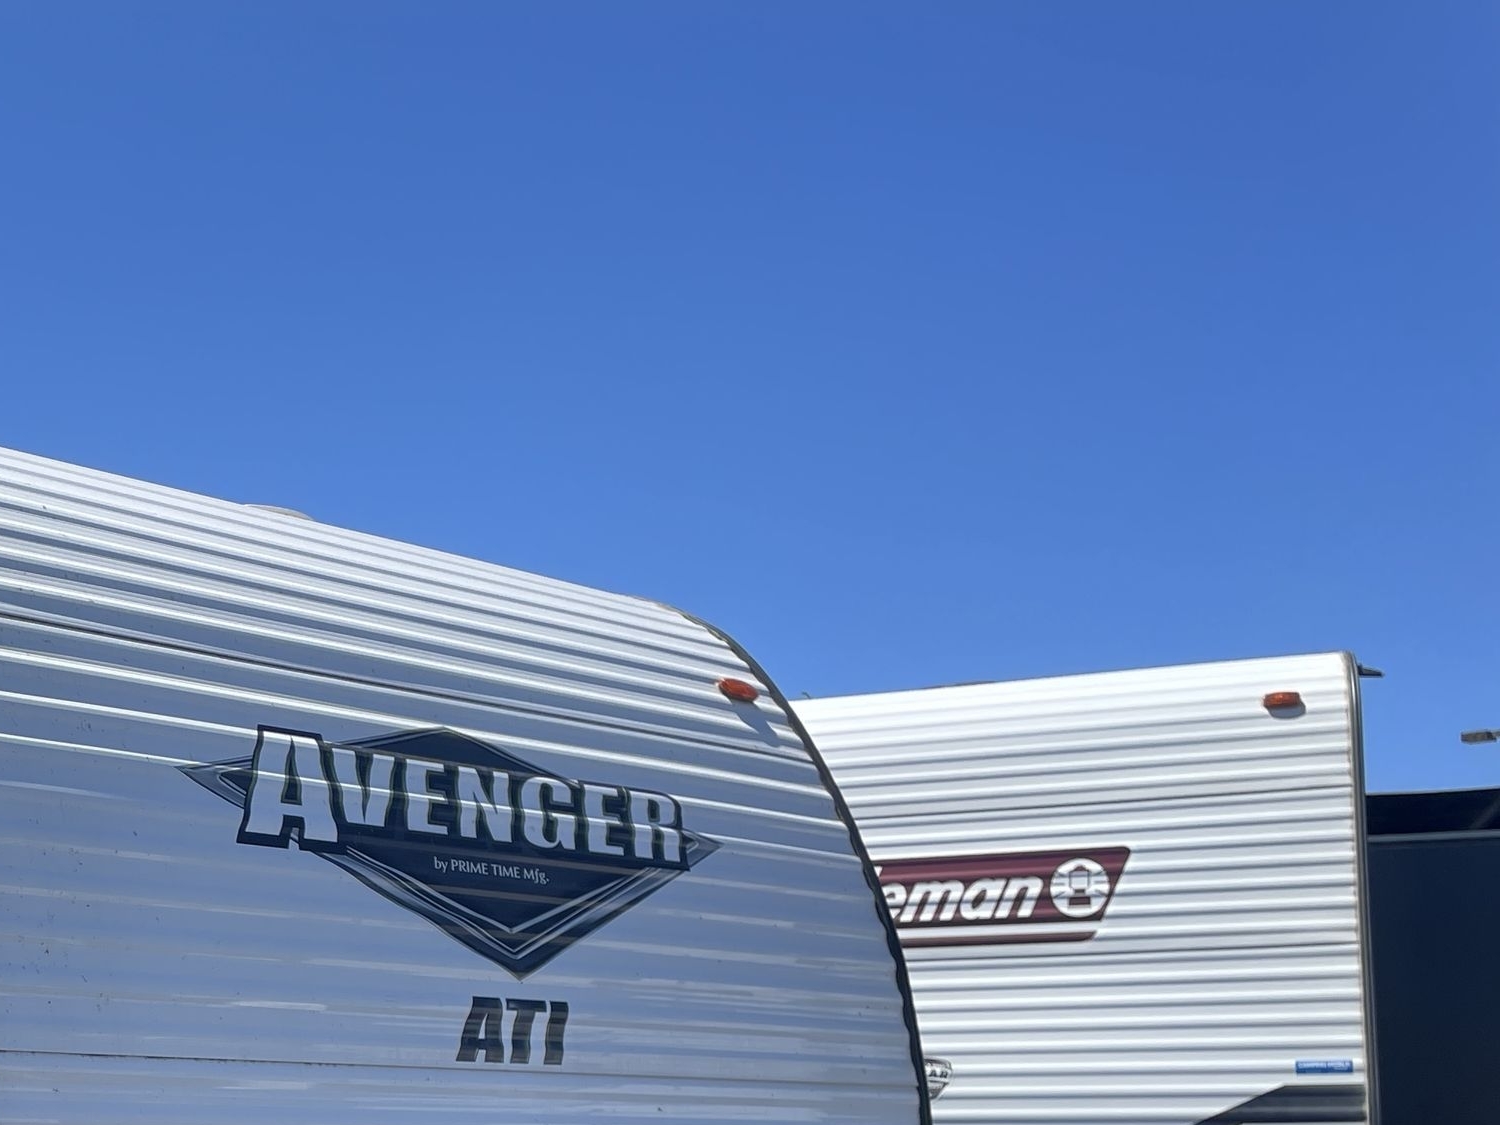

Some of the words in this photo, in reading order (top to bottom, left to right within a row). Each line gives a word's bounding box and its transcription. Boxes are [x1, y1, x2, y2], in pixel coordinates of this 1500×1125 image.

[238, 725, 689, 871] AVENGER
[433, 856, 448, 873] by
[451, 859, 489, 875] PRIME
[491, 863, 521, 879] TIME
[874, 865, 1044, 924] eman
[455, 995, 569, 1066] ATI
